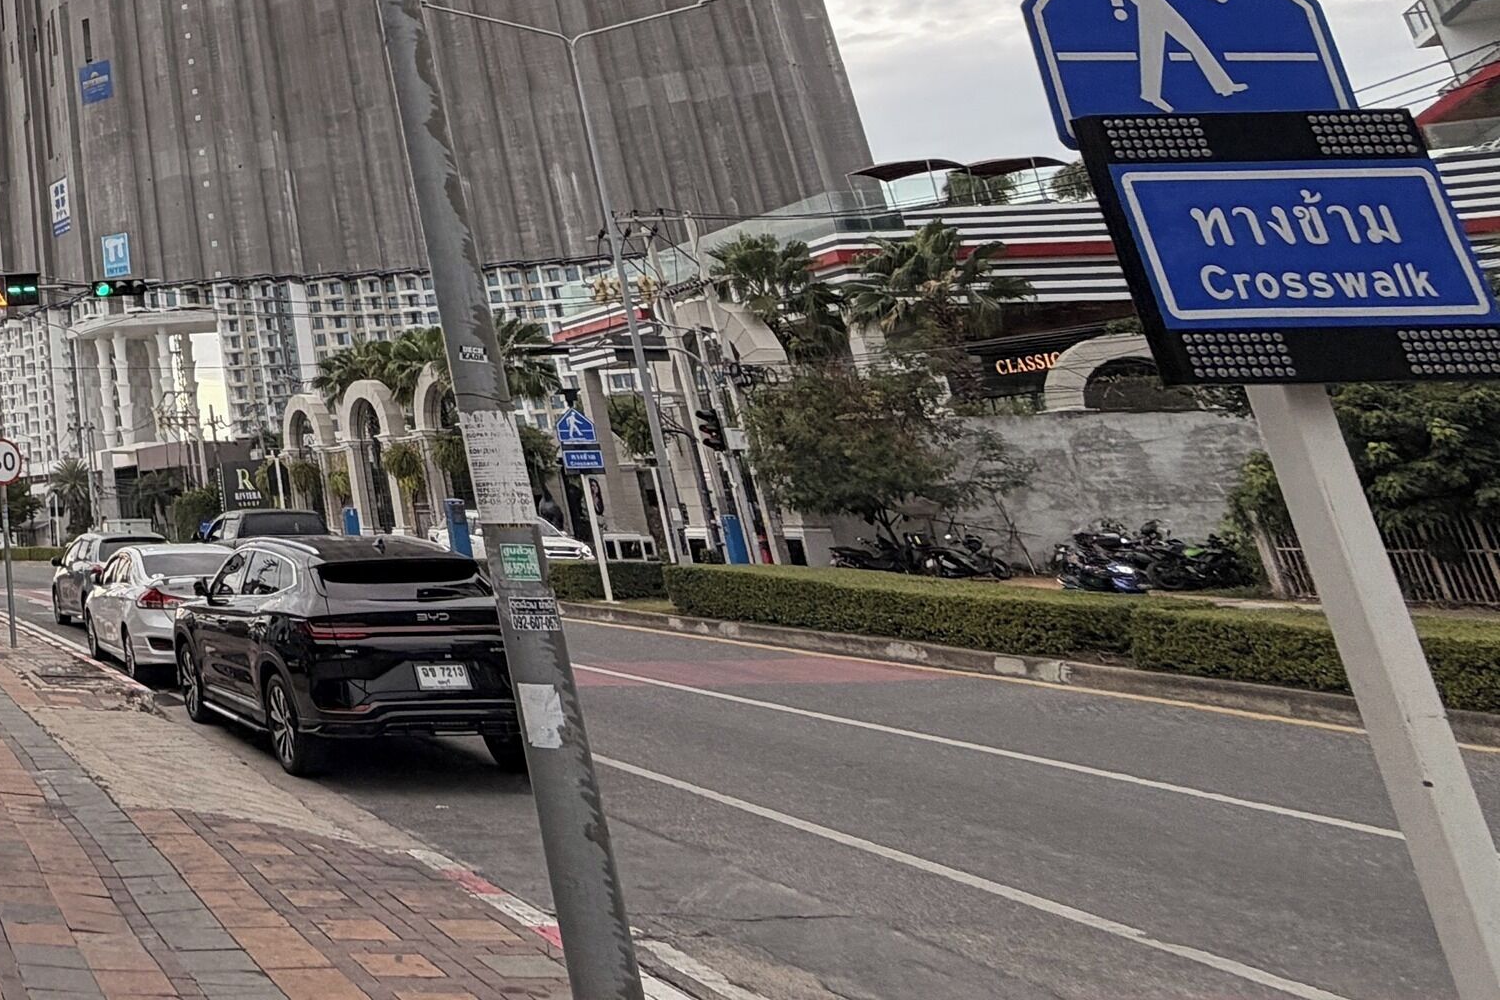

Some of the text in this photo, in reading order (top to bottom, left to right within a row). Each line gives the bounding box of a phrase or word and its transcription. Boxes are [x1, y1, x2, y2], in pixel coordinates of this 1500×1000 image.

[1190, 189, 1402, 246] ทางข้าม
[1200, 263, 1440, 300] Crosswalk
[235, 491, 262, 500] RIVIERA
[416, 612, 450, 621] BYD
[440, 666, 464, 678] 7213
